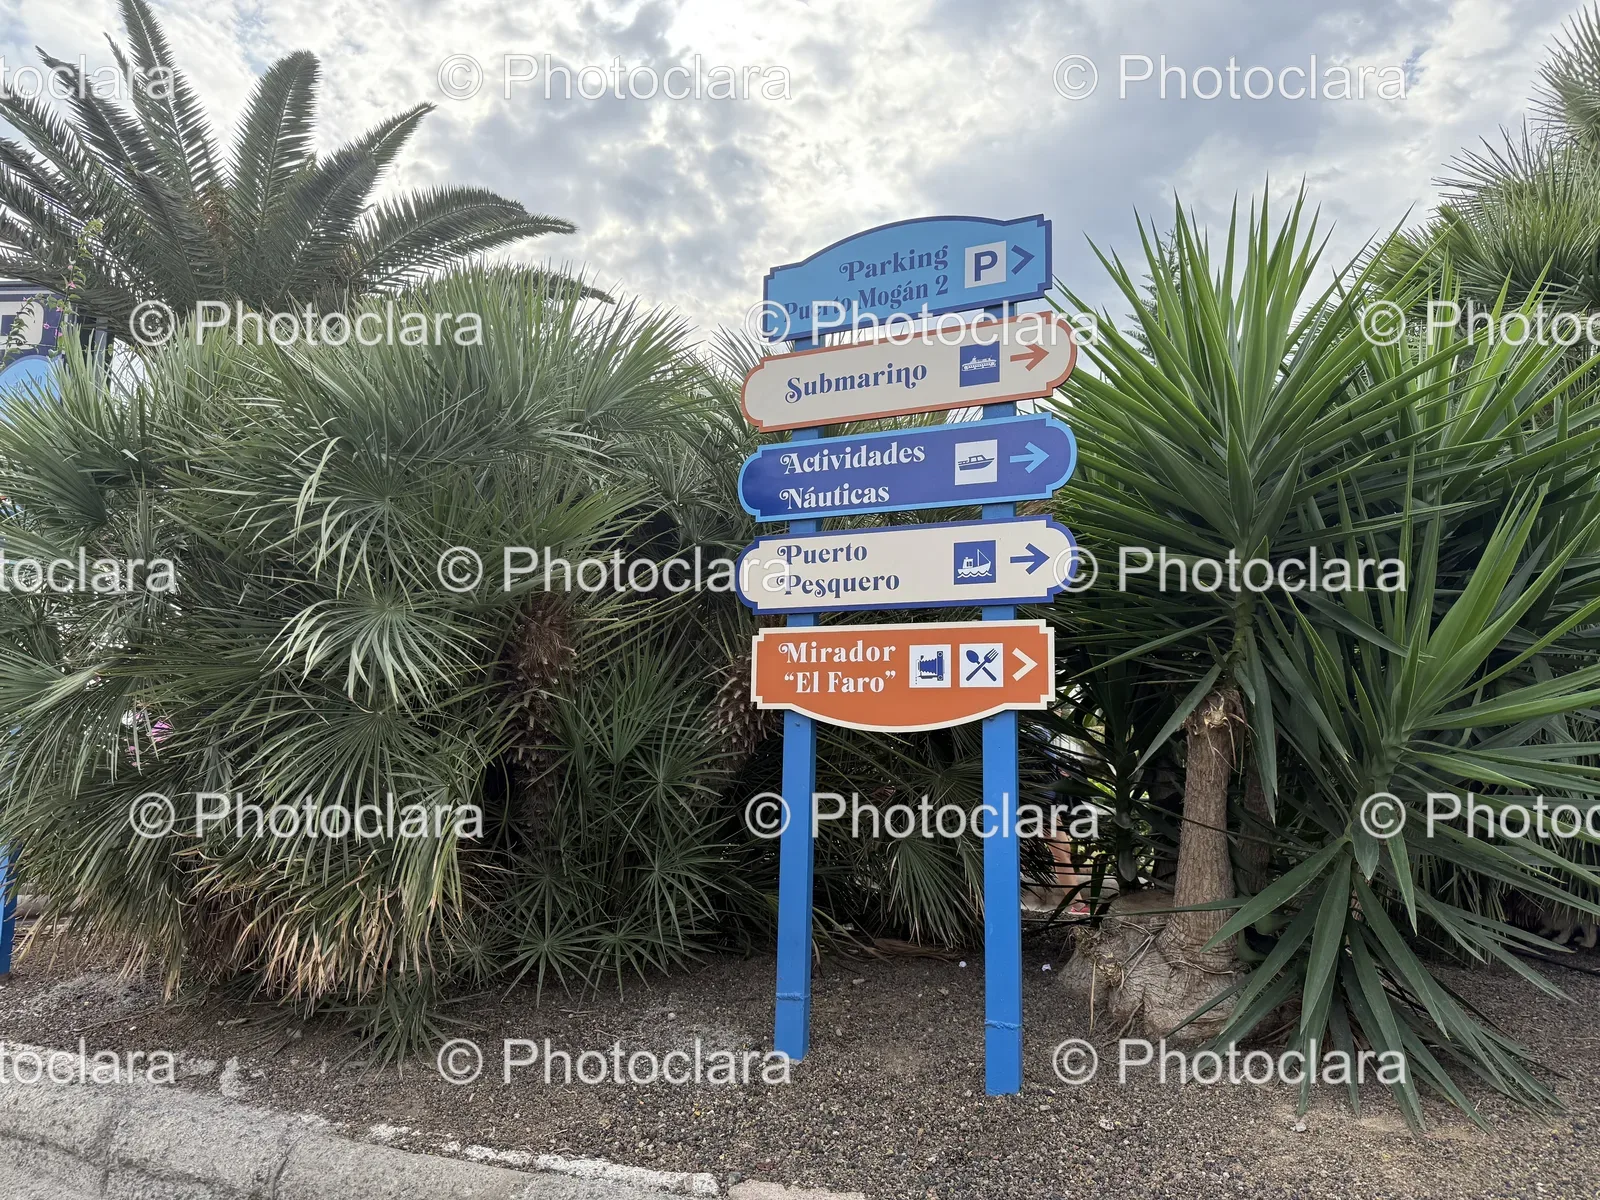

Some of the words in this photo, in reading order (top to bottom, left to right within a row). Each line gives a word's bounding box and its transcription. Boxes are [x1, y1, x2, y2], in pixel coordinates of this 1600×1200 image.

[839, 245, 949, 281] Parking
[974, 250, 998, 282] P
[858, 280, 928, 310] Mogán
[935, 274, 949, 296] 2
[785, 362, 927, 404] Submarino
[780, 441, 926, 475] Actividades
[779, 483, 890, 509] Náuticas
[777, 543, 868, 566] Puerto
[777, 572, 900, 599] Pesquero
[778, 640, 897, 664] Mirador
[784, 671, 820, 693] “El
[827, 670, 897, 693] Faro”
